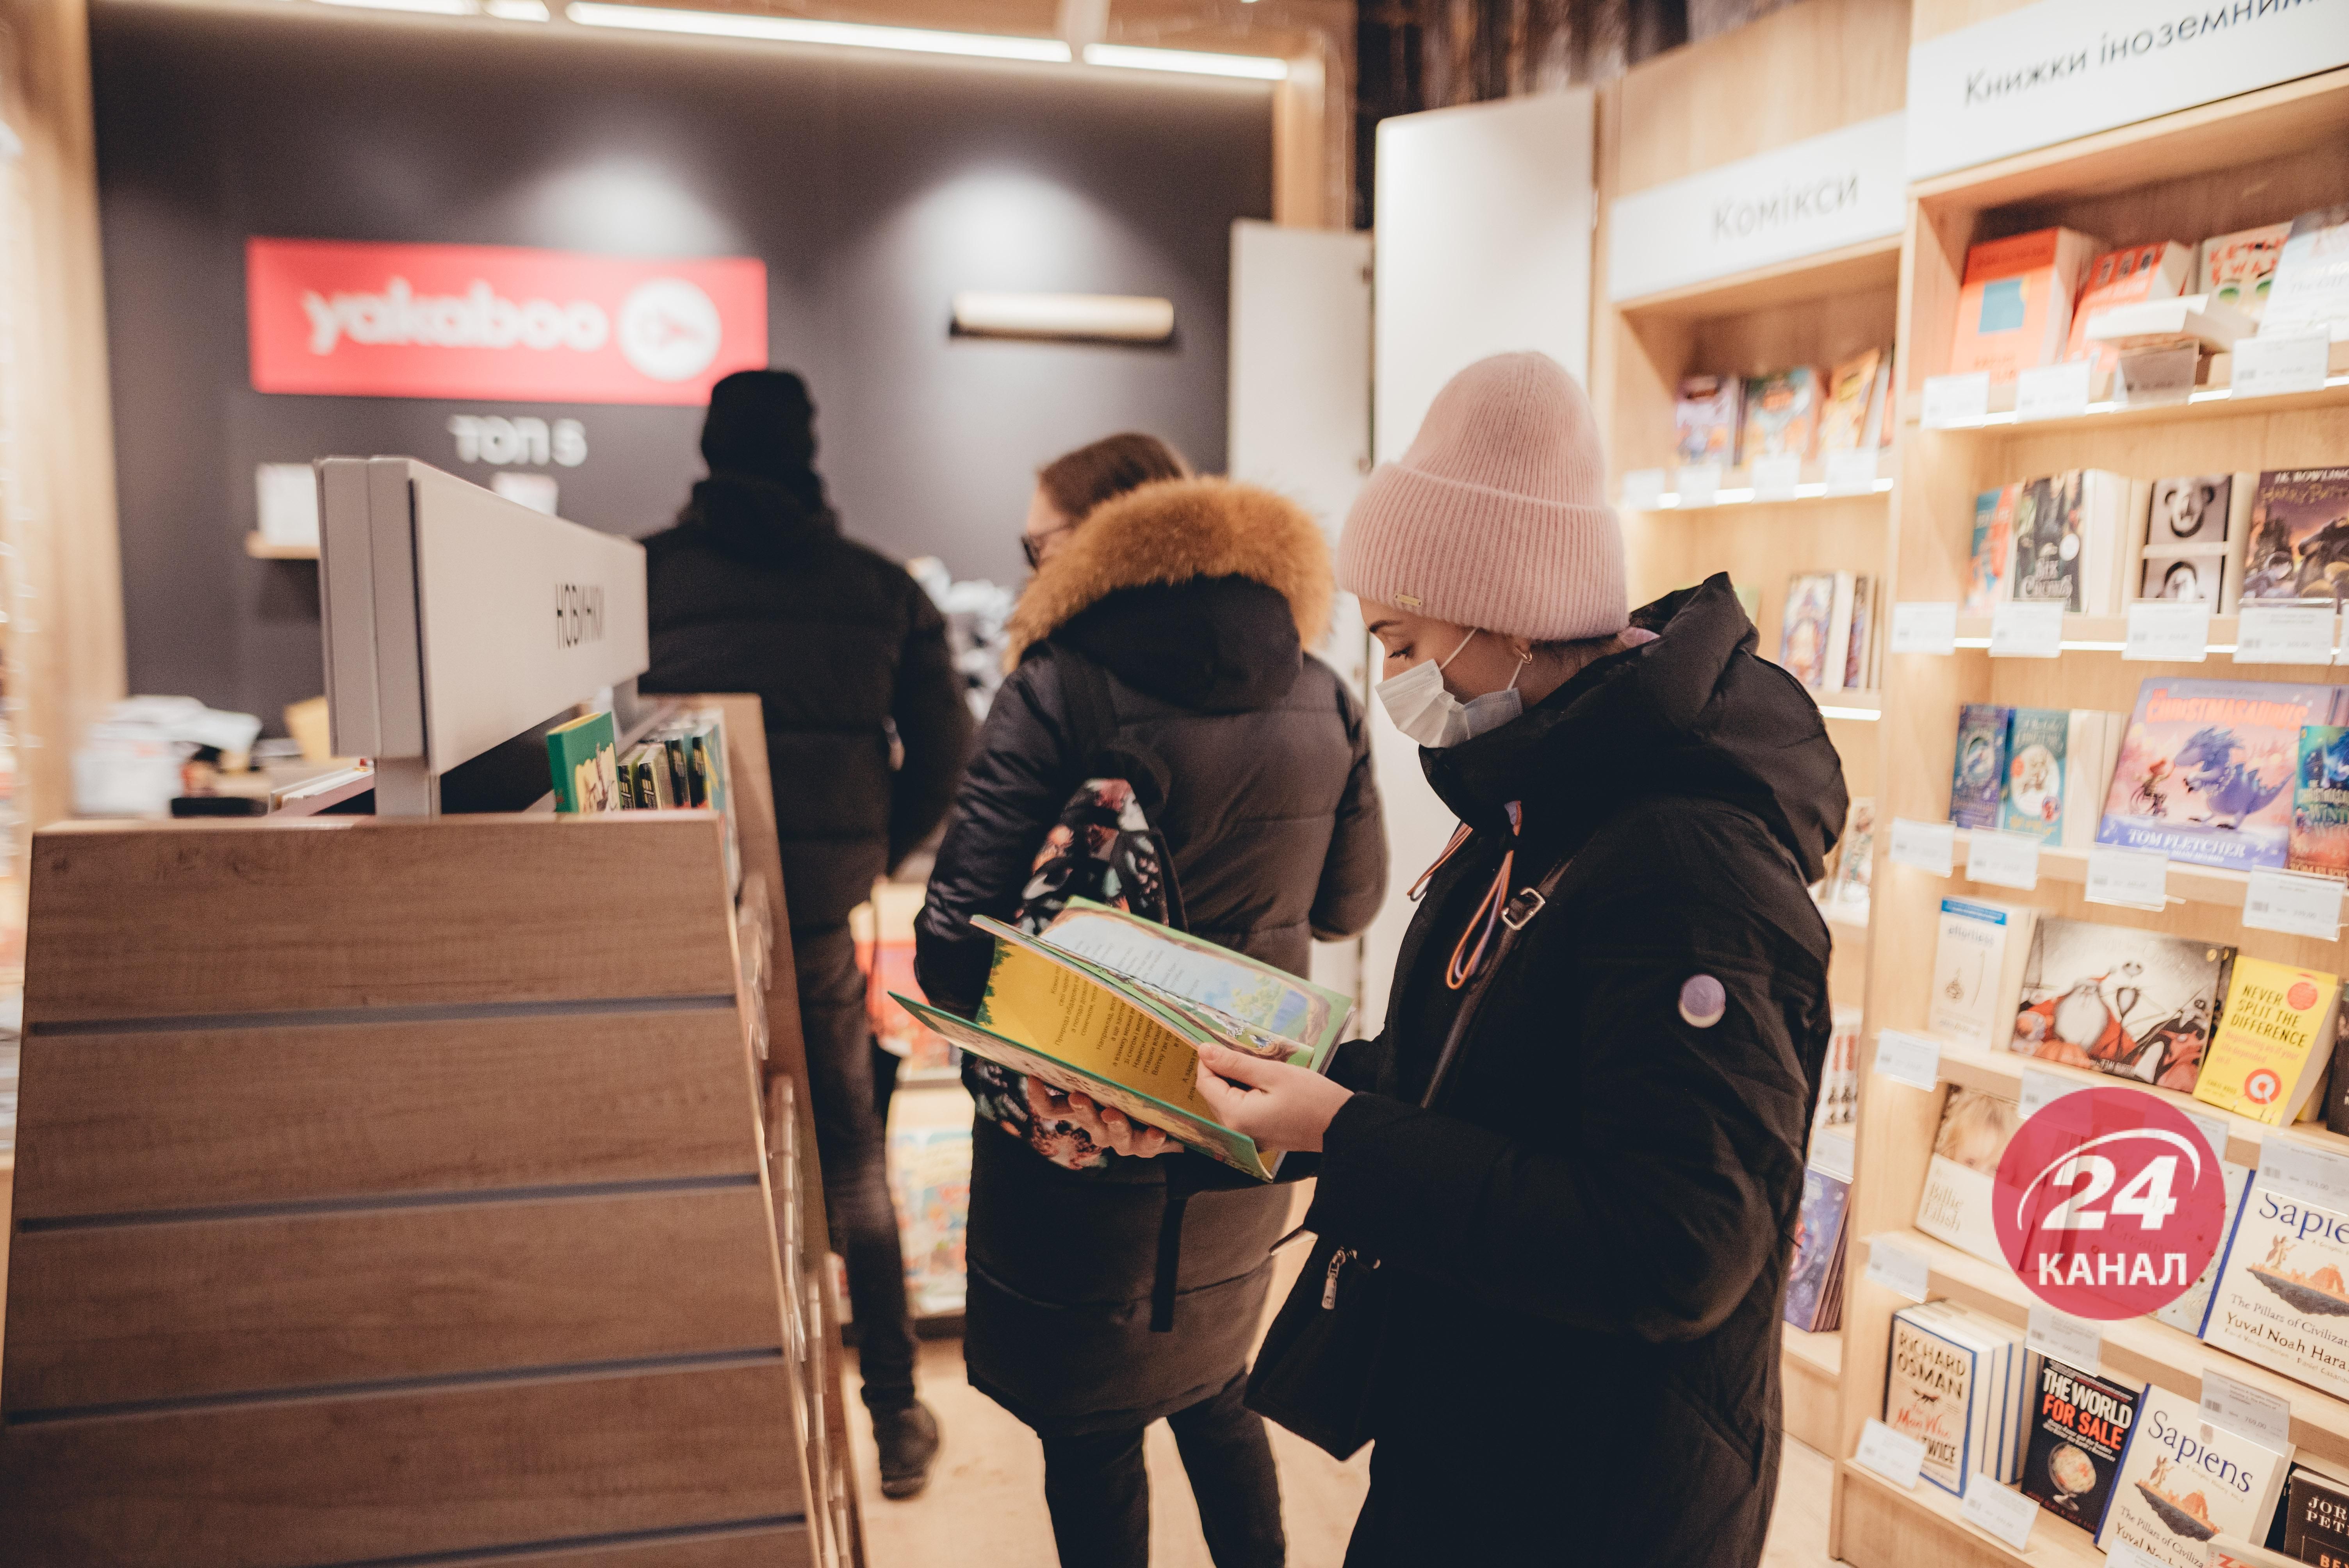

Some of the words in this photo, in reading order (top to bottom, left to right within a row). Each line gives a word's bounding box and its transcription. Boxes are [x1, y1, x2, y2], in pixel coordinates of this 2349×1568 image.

[1964, 48, 2087, 108] Книжки
[1713, 175, 1859, 239] Комікси
[303, 276, 609, 356] yakaboo
[447, 414, 549, 466] ТОП
[551, 419, 586, 468] 5
[2128, 828, 2164, 847] TOM
[2162, 833, 2247, 858] FLETCHER
[1050, 975, 1060, 994] Кожна
[2242, 984, 2284, 1007] NEVER
[1055, 1015, 1071, 1046] Природа
[1065, 983, 1080, 1015] обдаровує
[1072, 1004, 1084, 1028] погода
[1080, 1003, 1095, 1036] сонечком,
[1096, 1011, 1114, 1051] Наприклад,
[1112, 1026, 1120, 1036] ще
[2230, 1014, 2308, 1048] DIFFERENCE
[2237, 998, 2272, 1018] SPLIT
[2275, 1009, 2302, 1028] THE
[1115, 1036, 1128, 1062] взимку
[1123, 1014, 1134, 1036] можна
[1126, 1035, 1138, 1058] снігом
[1132, 1041, 1147, 1068] Навесні
[1142, 1046, 1156, 1073] пташки
[1151, 1053, 1166, 1076] Влітку
[1160, 1041, 1169, 1053] так
[1930, 1180, 1964, 1210] Billie
[2230, 1293, 2251, 1309] The
[2253, 1302, 2285, 1323] Pillars
[2287, 1318, 2302, 1327] of
[2301, 1321, 2349, 1349] Civilizat
[1898, 1331, 1966, 1377] RICHARD
[2226, 1311, 2263, 1336] Yuval
[2266, 1327, 2305, 1353] Noah
[2310, 1344, 2349, 1372] Hara
[1896, 1352, 1963, 1401] OSMAN
[2042, 1368, 2073, 1402] THE
[2071, 1381, 2133, 1429] WORLD
[2042, 1393, 2076, 1429] FOR
[2077, 1411, 2124, 1451] SALE
[2148, 1410, 2254, 1493] Sapiens
[2120, 1505, 2135, 1523] The
[2136, 1517, 2161, 1540] Pillars
[2161, 1536, 2172, 1547] of
[2308, 1496, 2347, 1520] JOR
[2116, 1522, 2144, 1548] Yuval
